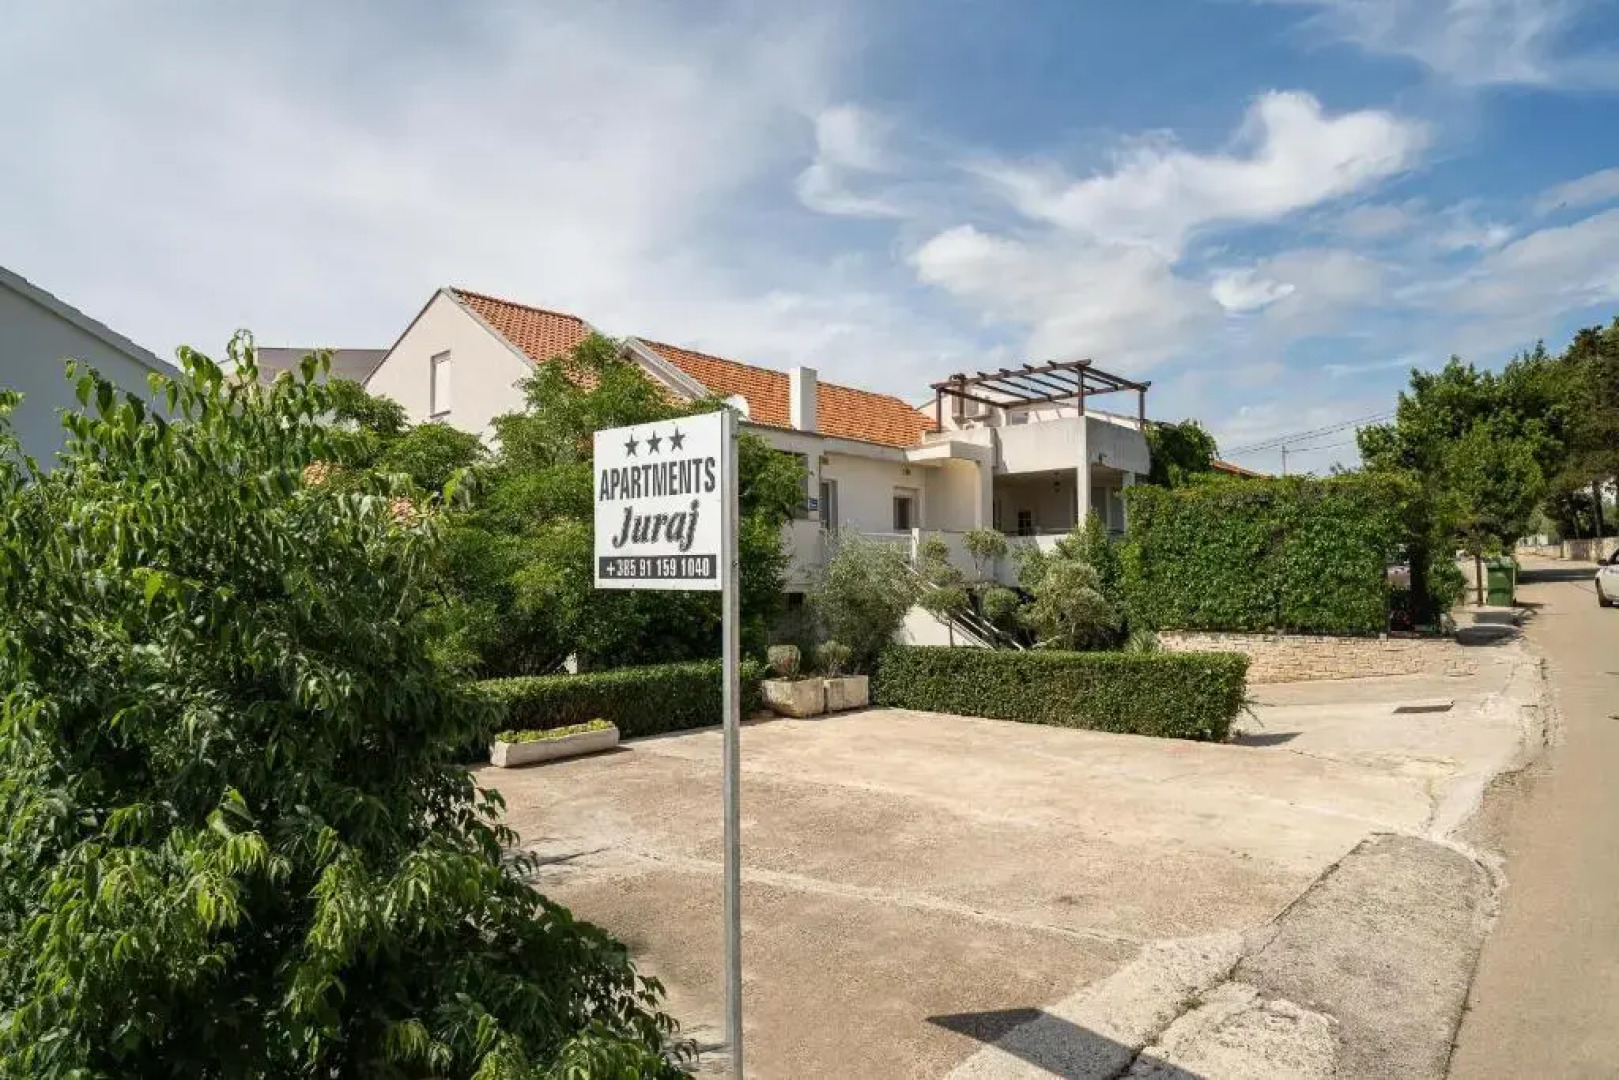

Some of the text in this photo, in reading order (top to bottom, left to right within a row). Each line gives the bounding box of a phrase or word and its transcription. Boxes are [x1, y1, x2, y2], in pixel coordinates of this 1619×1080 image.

[599, 456, 716, 501] APARTMENTS
[612, 499, 700, 552] Juraj
[606, 557, 710, 577] +385 91 159 1040
